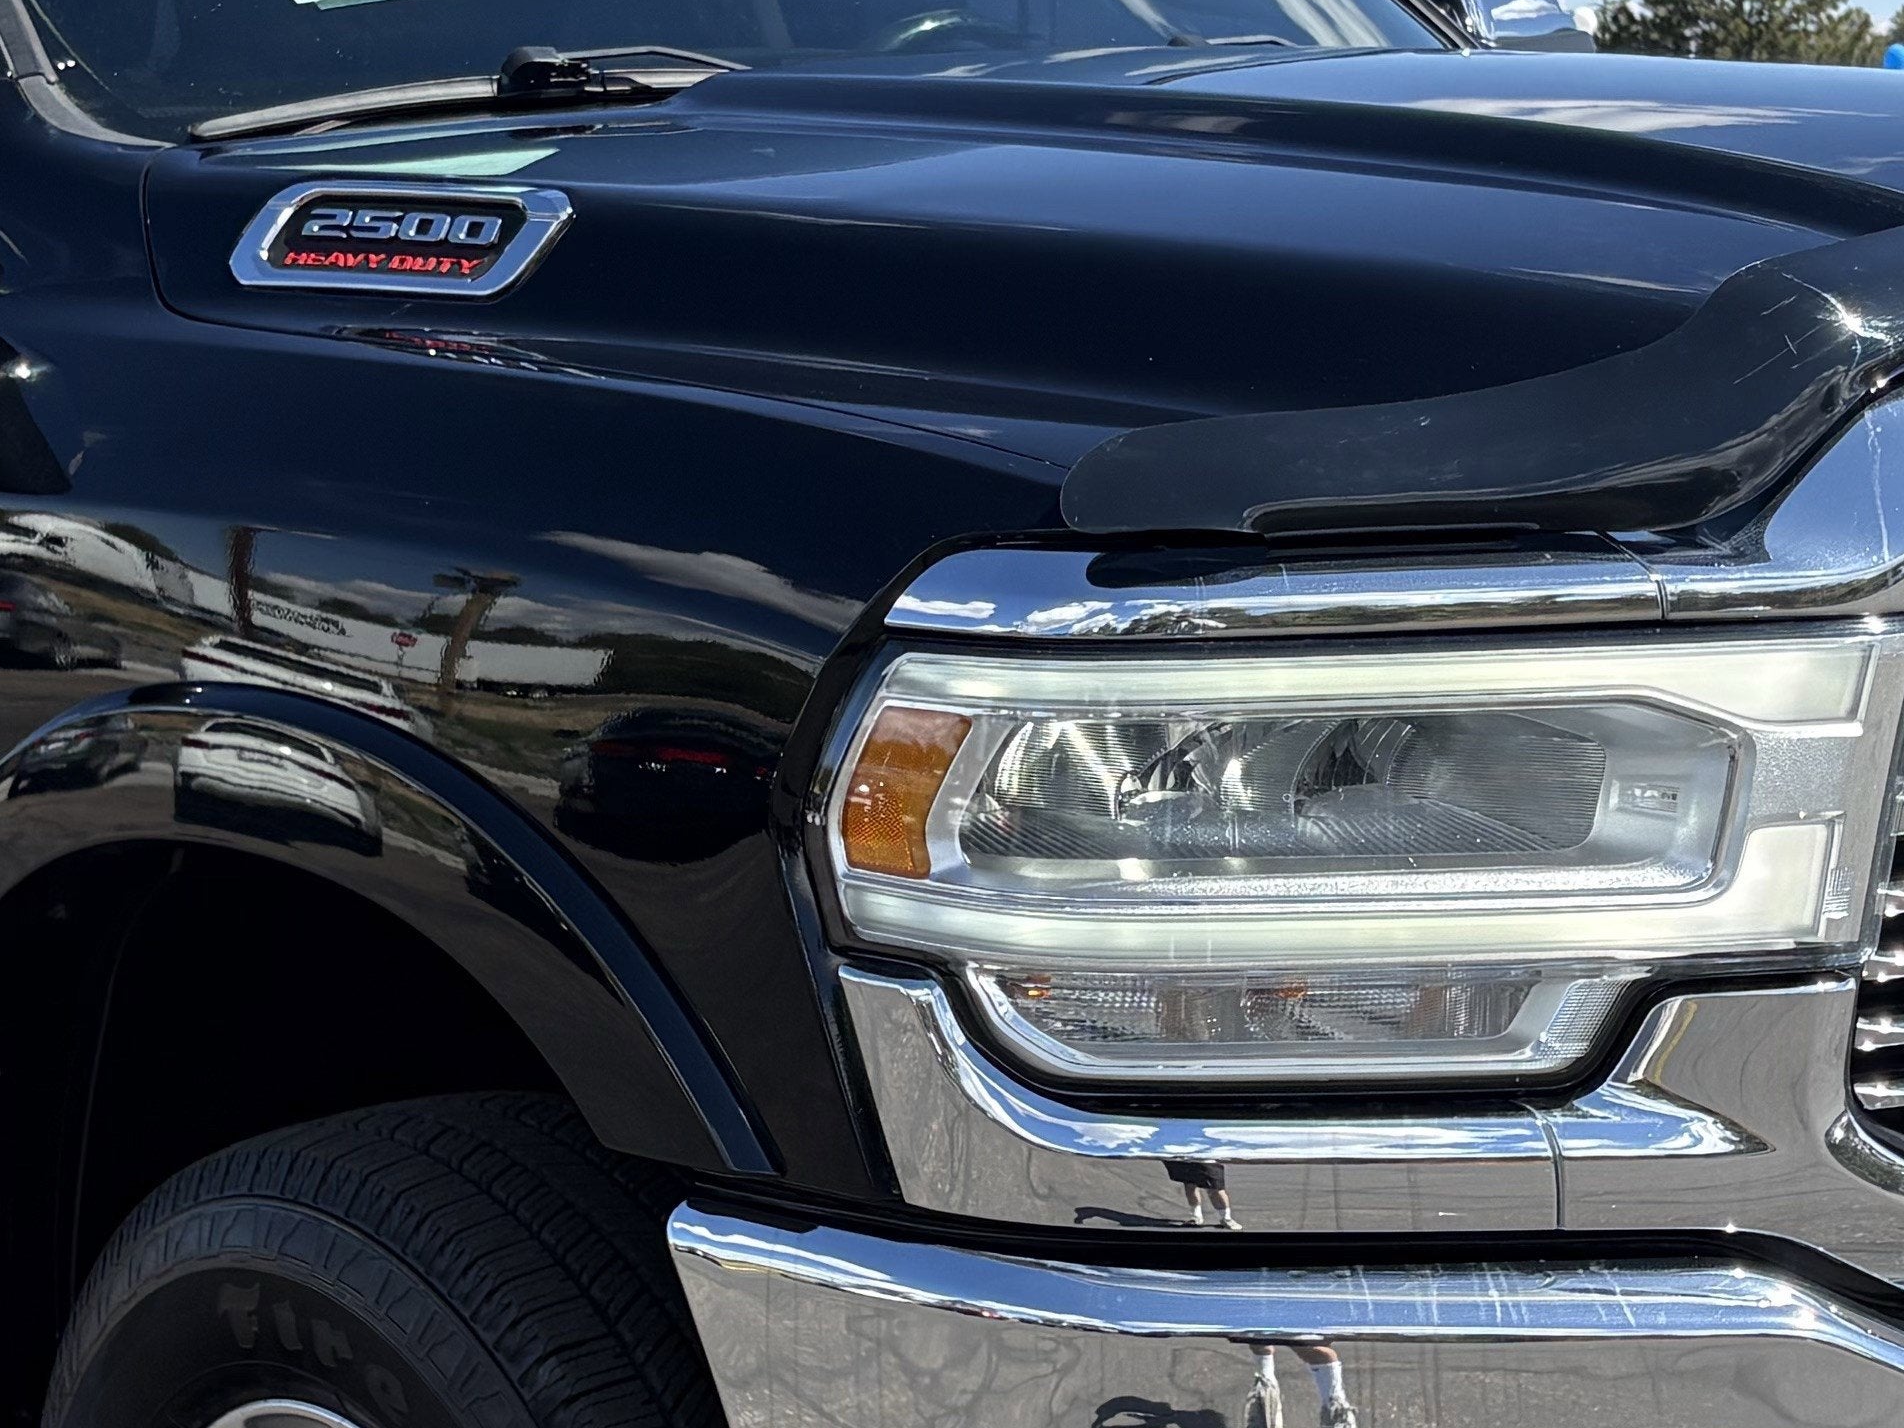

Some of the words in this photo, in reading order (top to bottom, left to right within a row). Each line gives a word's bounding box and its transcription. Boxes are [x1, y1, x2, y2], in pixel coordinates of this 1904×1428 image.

[301, 208, 502, 246] 2500
[284, 252, 385, 269] HEAVY
[388, 256, 481, 274] DUTY
